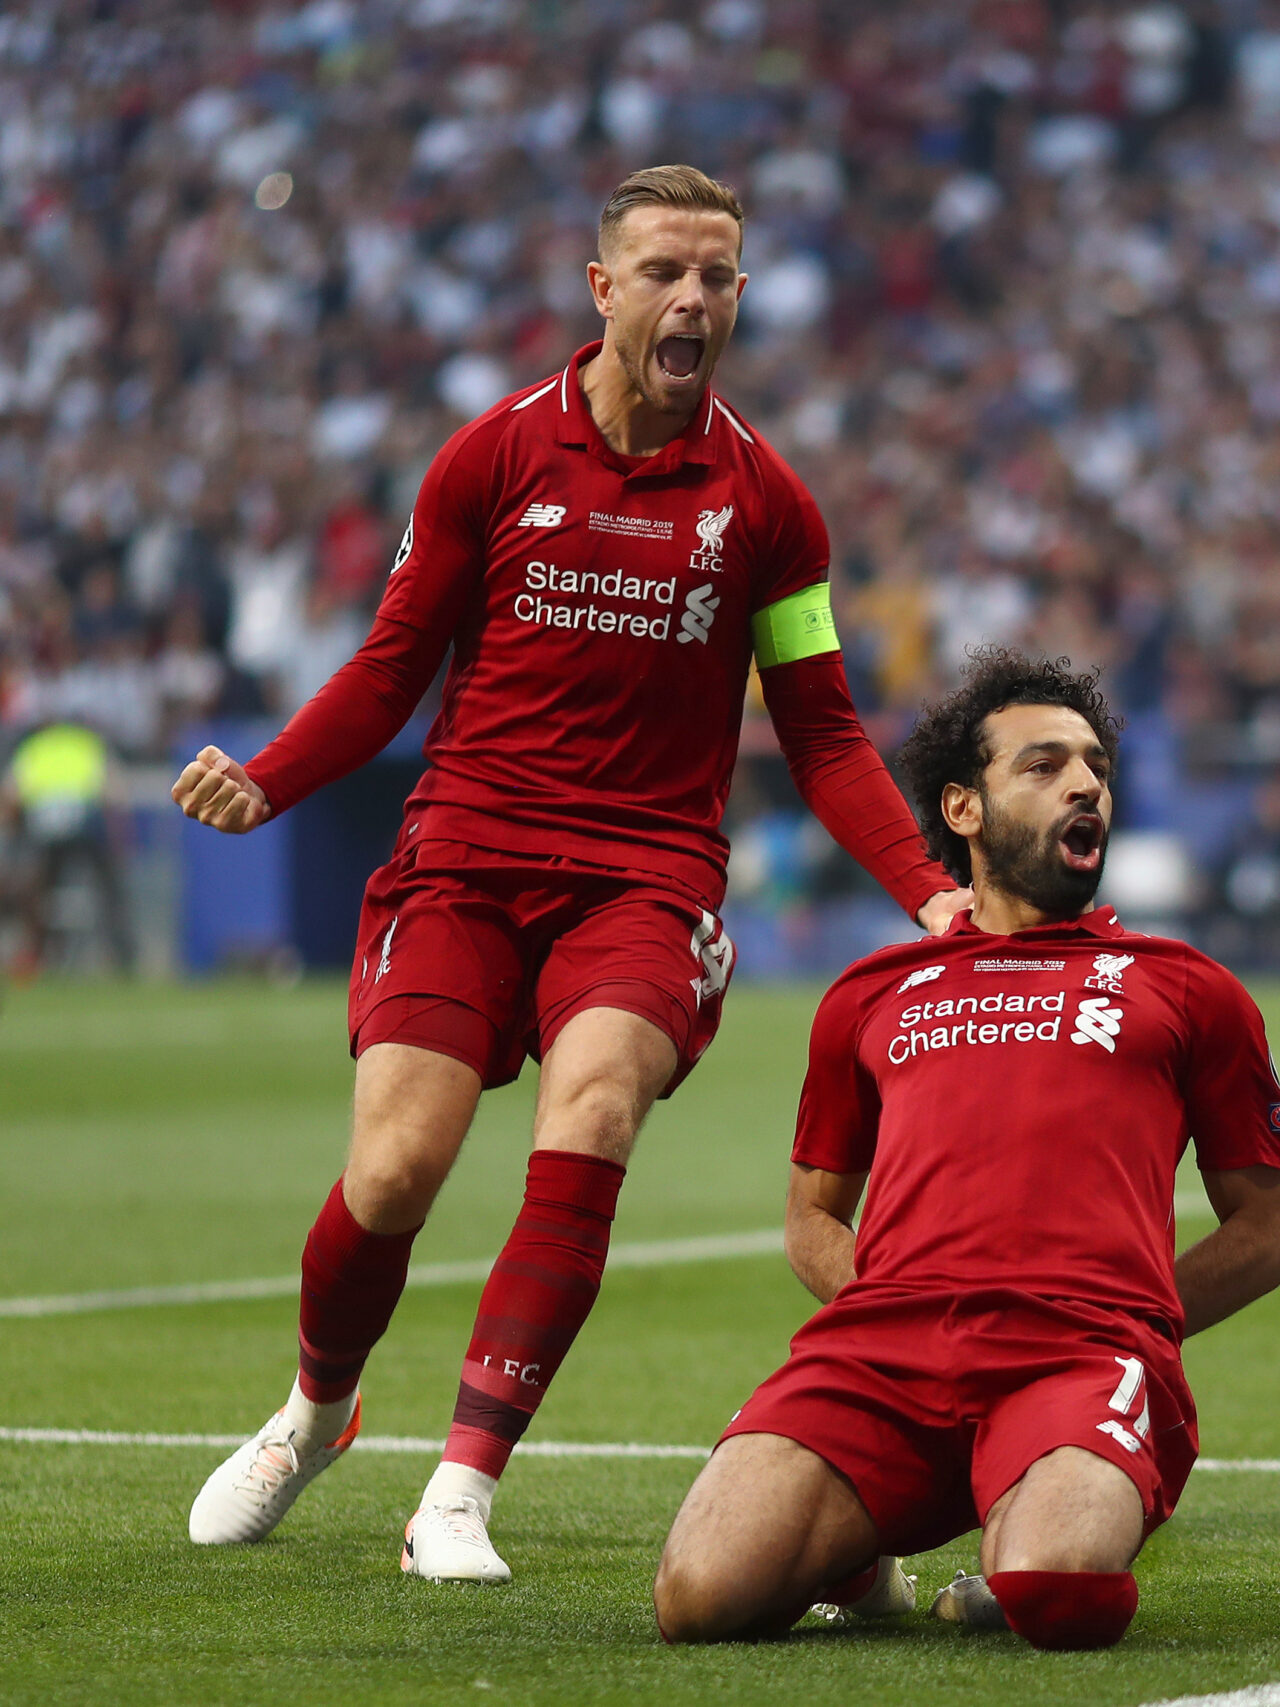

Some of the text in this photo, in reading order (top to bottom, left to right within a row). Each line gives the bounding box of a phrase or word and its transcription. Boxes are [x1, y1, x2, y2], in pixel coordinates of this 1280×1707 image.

[589, 511, 674, 529] FINAL MADRID 2019
[525, 560, 677, 605] Standard
[689, 554, 724, 573] L.F.C.
[514, 593, 671, 641] Chartered
[690, 904, 734, 1000] 14
[1083, 978, 1125, 995] L.F.C.
[899, 991, 1065, 1029] Standard
[888, 1016, 1062, 1065] Chartered
